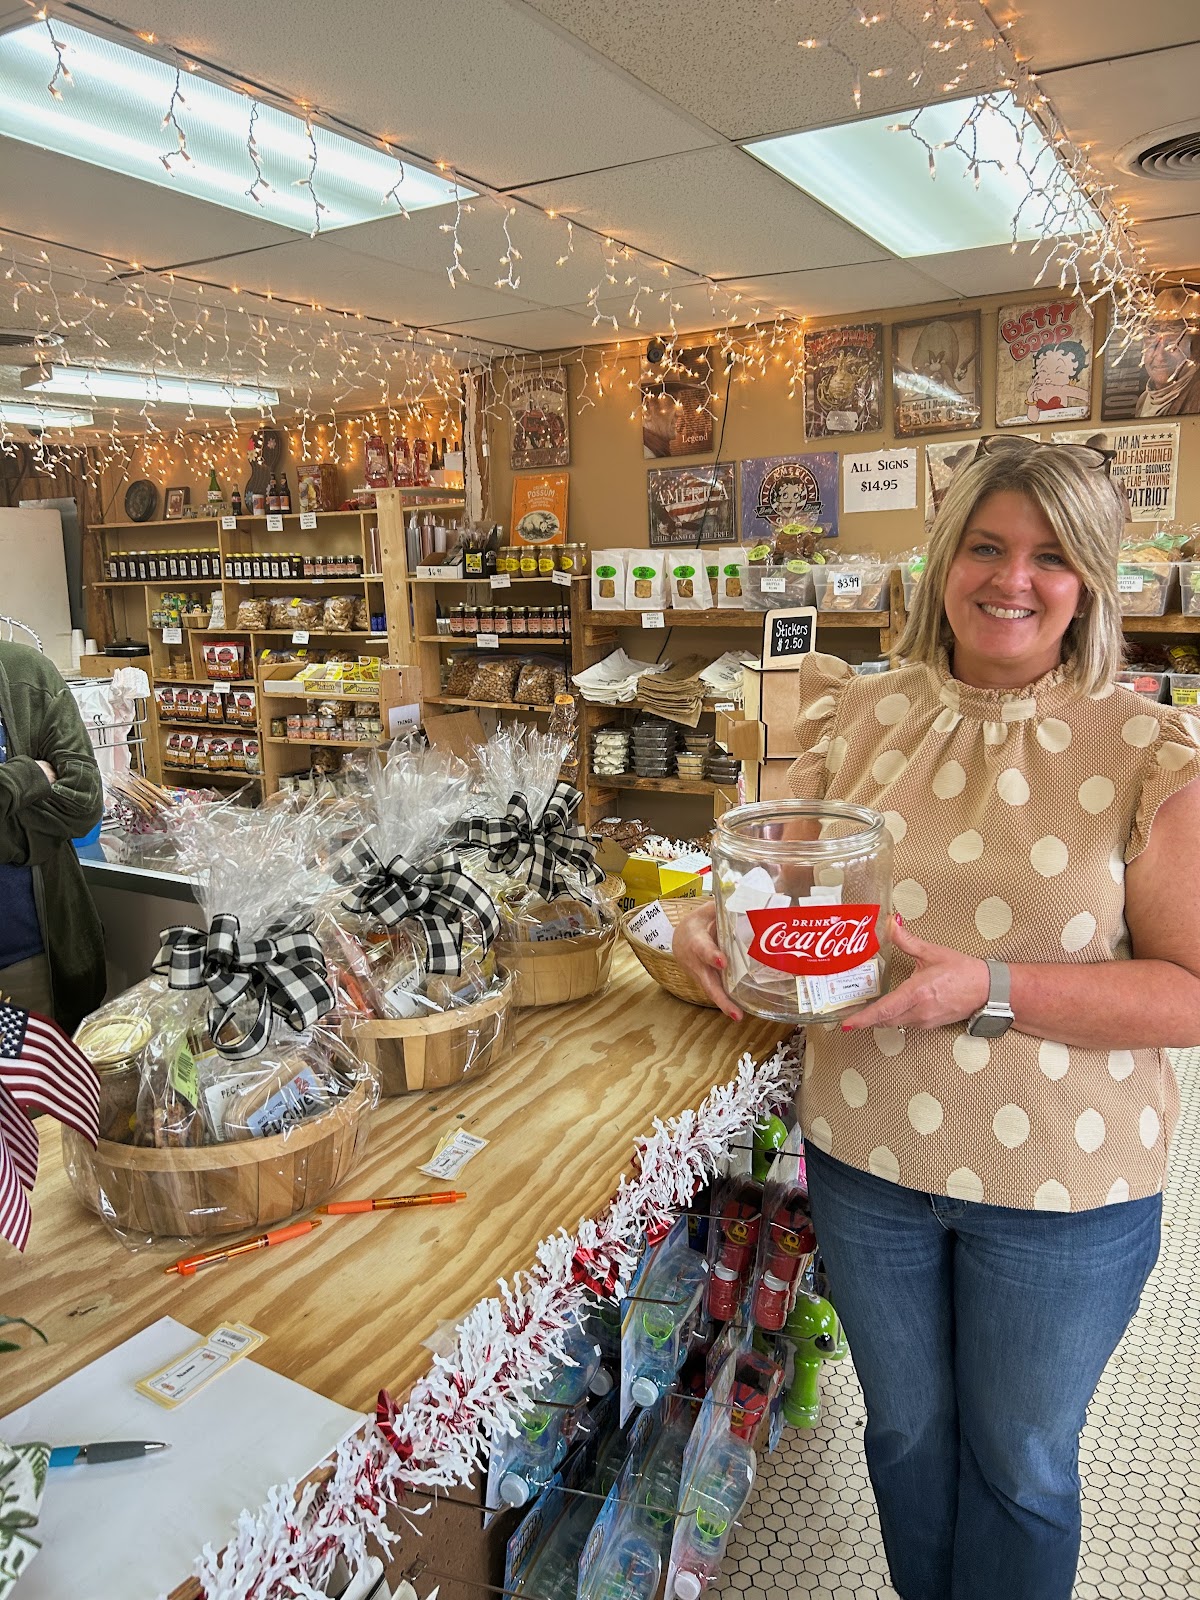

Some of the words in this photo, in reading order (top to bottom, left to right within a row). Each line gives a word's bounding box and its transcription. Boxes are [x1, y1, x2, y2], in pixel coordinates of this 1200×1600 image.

[1000, 301, 1078, 344] BETTY
[1009, 323, 1073, 361] BOOP
[902, 410, 942, 427] BACK
[681, 432, 708, 443] Legend
[1113, 436, 1117, 450] I
[1117, 435, 1129, 450] AM
[1130, 434, 1141, 449] AN
[850, 462, 872, 473] ALL
[877, 459, 909, 471] SIGNS
[1112, 463, 1171, 476] HONEST-TO-GOODNESS
[762, 484, 772, 504] ALL
[773, 466, 816, 500] AMERICAN
[860, 479, 898, 492] $14.95
[1126, 473, 1170, 487] FLAG-WAVING
[527, 489, 555, 499] POSSUM
[656, 483, 730, 506] AMERICA
[1126, 486, 1170, 507] PATRIOT
[836, 576, 859, 589] $3.99
[775, 620, 809, 637] Stickers
[776, 637, 783, 652] $
[784, 638, 804, 650] 2.50
[645, 904, 661, 920] Book
[791, 918, 831, 927] DRINK
[644, 929, 659, 945] Marks
[759, 915, 874, 959] Coca-Cola
